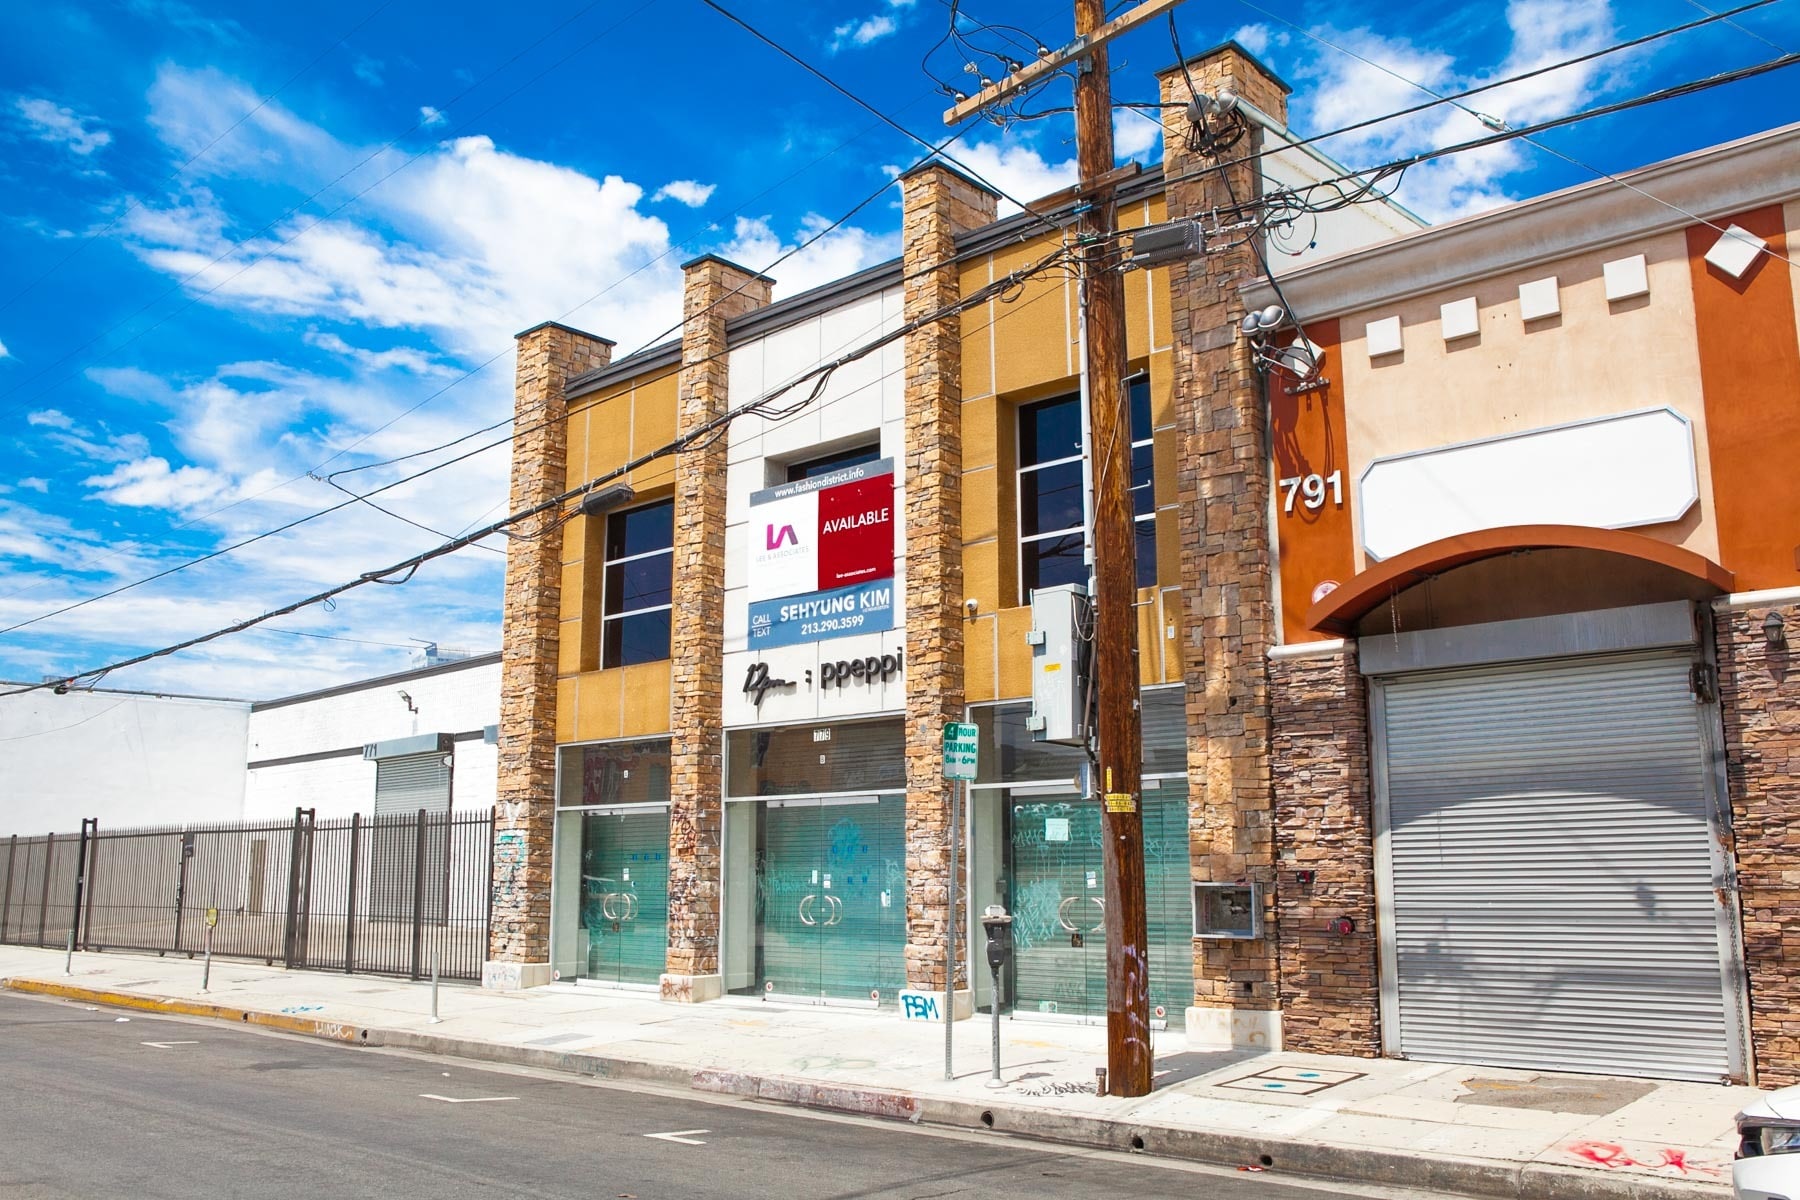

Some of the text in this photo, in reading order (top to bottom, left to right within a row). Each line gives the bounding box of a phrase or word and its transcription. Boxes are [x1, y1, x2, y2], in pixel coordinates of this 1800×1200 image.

[774, 467, 865, 498] www.fashiondistrict.info
[1279, 469, 1343, 512] 791
[822, 507, 890, 535] AVAILABLE
[780, 588, 890, 622] SEHYUNG KIM
[752, 613, 772, 625] CALL
[801, 614, 865, 635] 213.290.3599
[752, 626, 772, 637] TEXT
[820, 646, 903, 689] ppeppi
[813, 728, 830, 742] 779
[948, 725, 977, 739] 4 HOUR
[944, 741, 977, 754] PARKING
